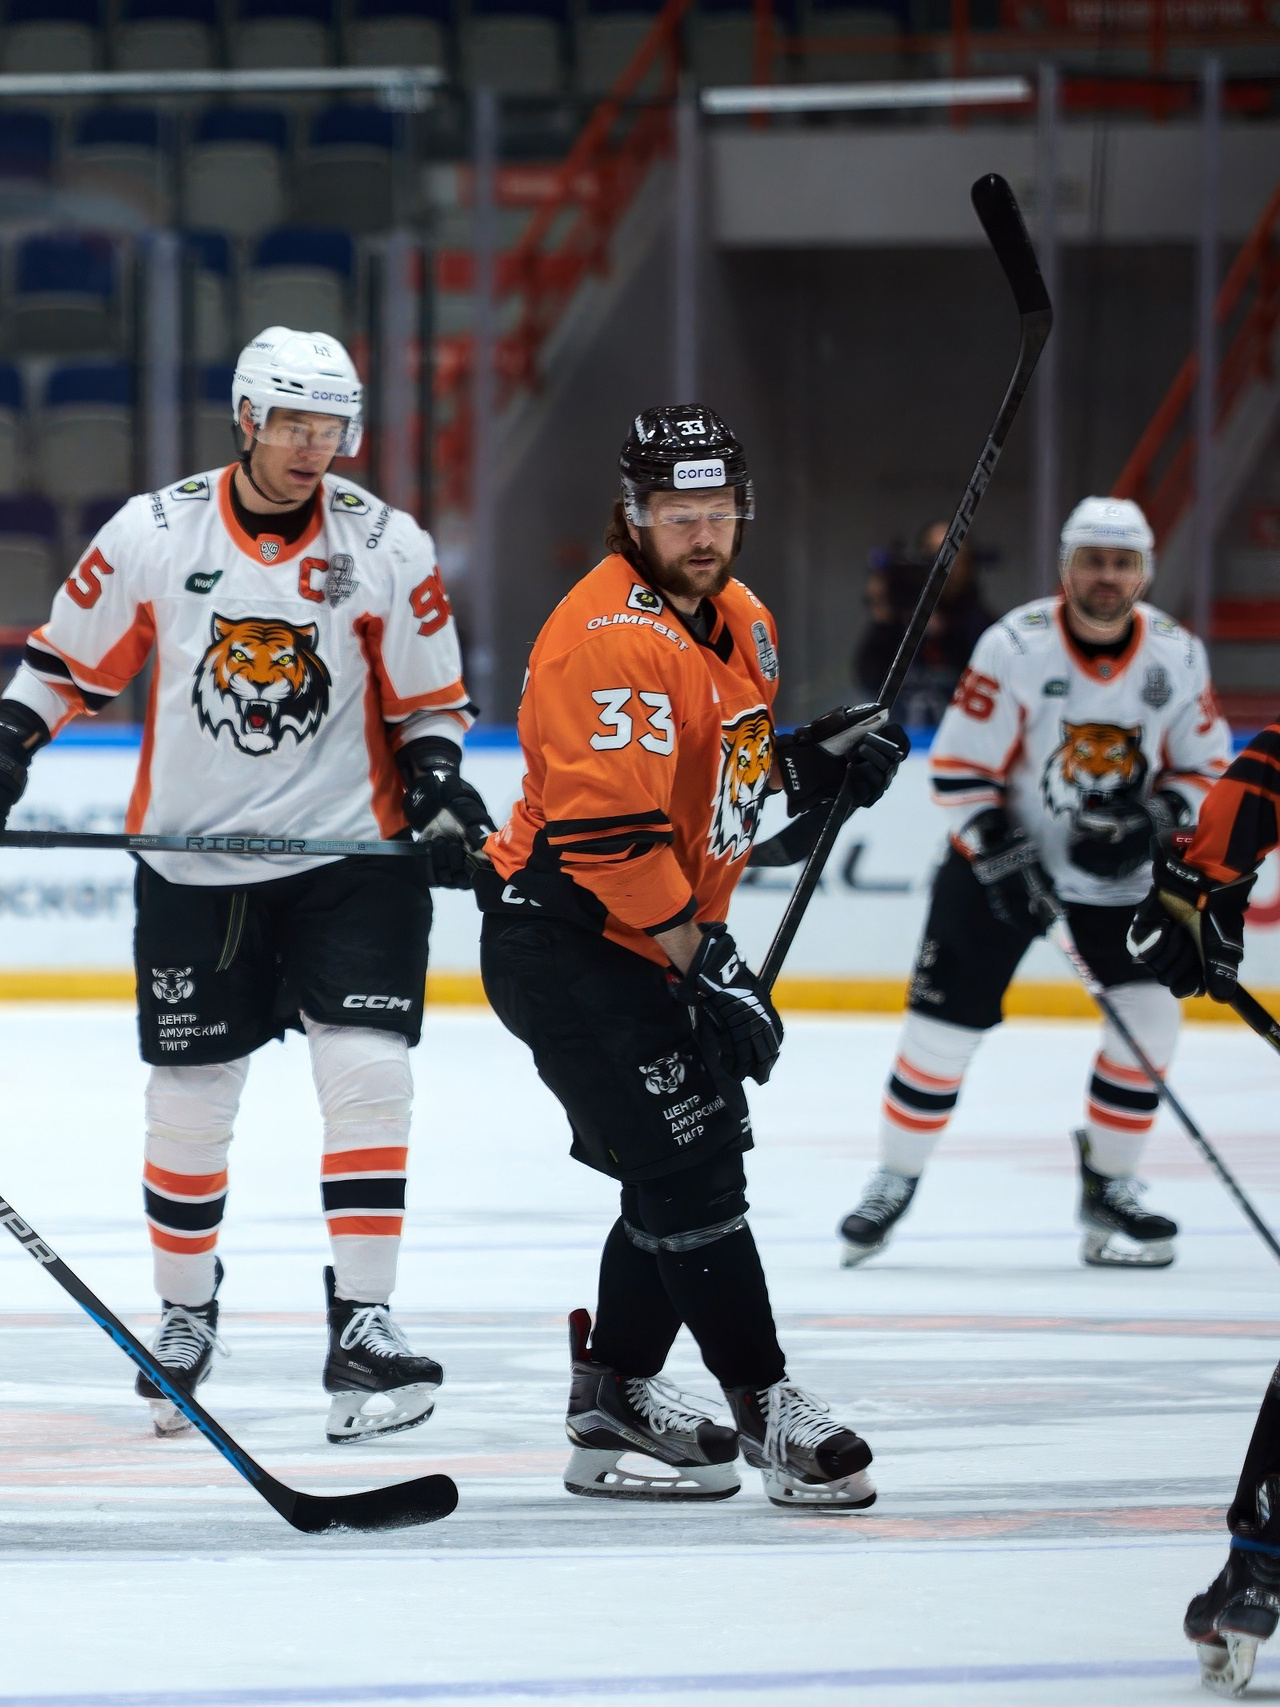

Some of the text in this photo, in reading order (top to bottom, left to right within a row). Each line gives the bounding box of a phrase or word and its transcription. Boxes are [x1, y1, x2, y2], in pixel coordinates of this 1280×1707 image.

[677, 420, 706, 436] 33
[677, 467, 723, 480] согаз
[586, 613, 689, 651] OLIMPBET
[589, 686, 676, 757] 33
[185, 835, 307, 853] RIBCOR
[1176, 836, 1194, 844] CC
[342, 994, 412, 1012] CCM
[157, 1014, 198, 1026] ЦЕНТР
[159, 1021, 228, 1039] АМУРСКИЙ
[159, 1040, 190, 1051] ТИГР
[663, 1094, 701, 1121] ЦЕНТР
[671, 1095, 727, 1134] АМУРСКИЙ
[673, 1125, 705, 1146] ТИГР
